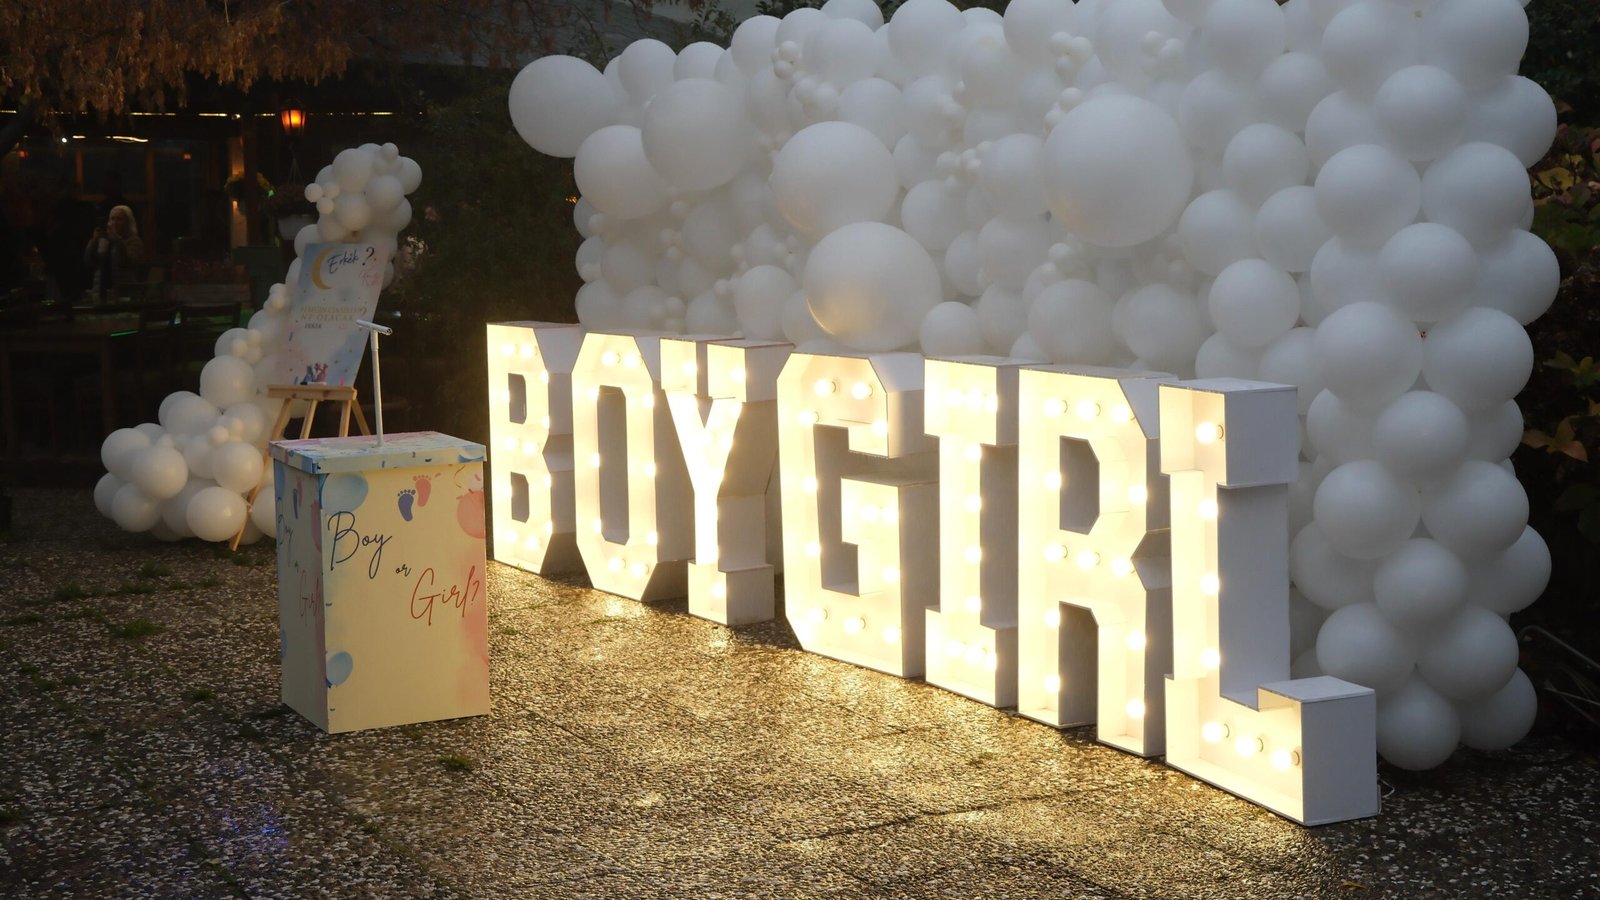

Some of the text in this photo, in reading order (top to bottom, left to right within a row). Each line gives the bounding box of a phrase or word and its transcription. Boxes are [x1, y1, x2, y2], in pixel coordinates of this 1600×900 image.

[327, 511, 392, 579] Boy
[395, 564, 411, 577] or
[487, 322, 1310, 827] BOY GIRL
[411, 565, 480, 626] Girl?
